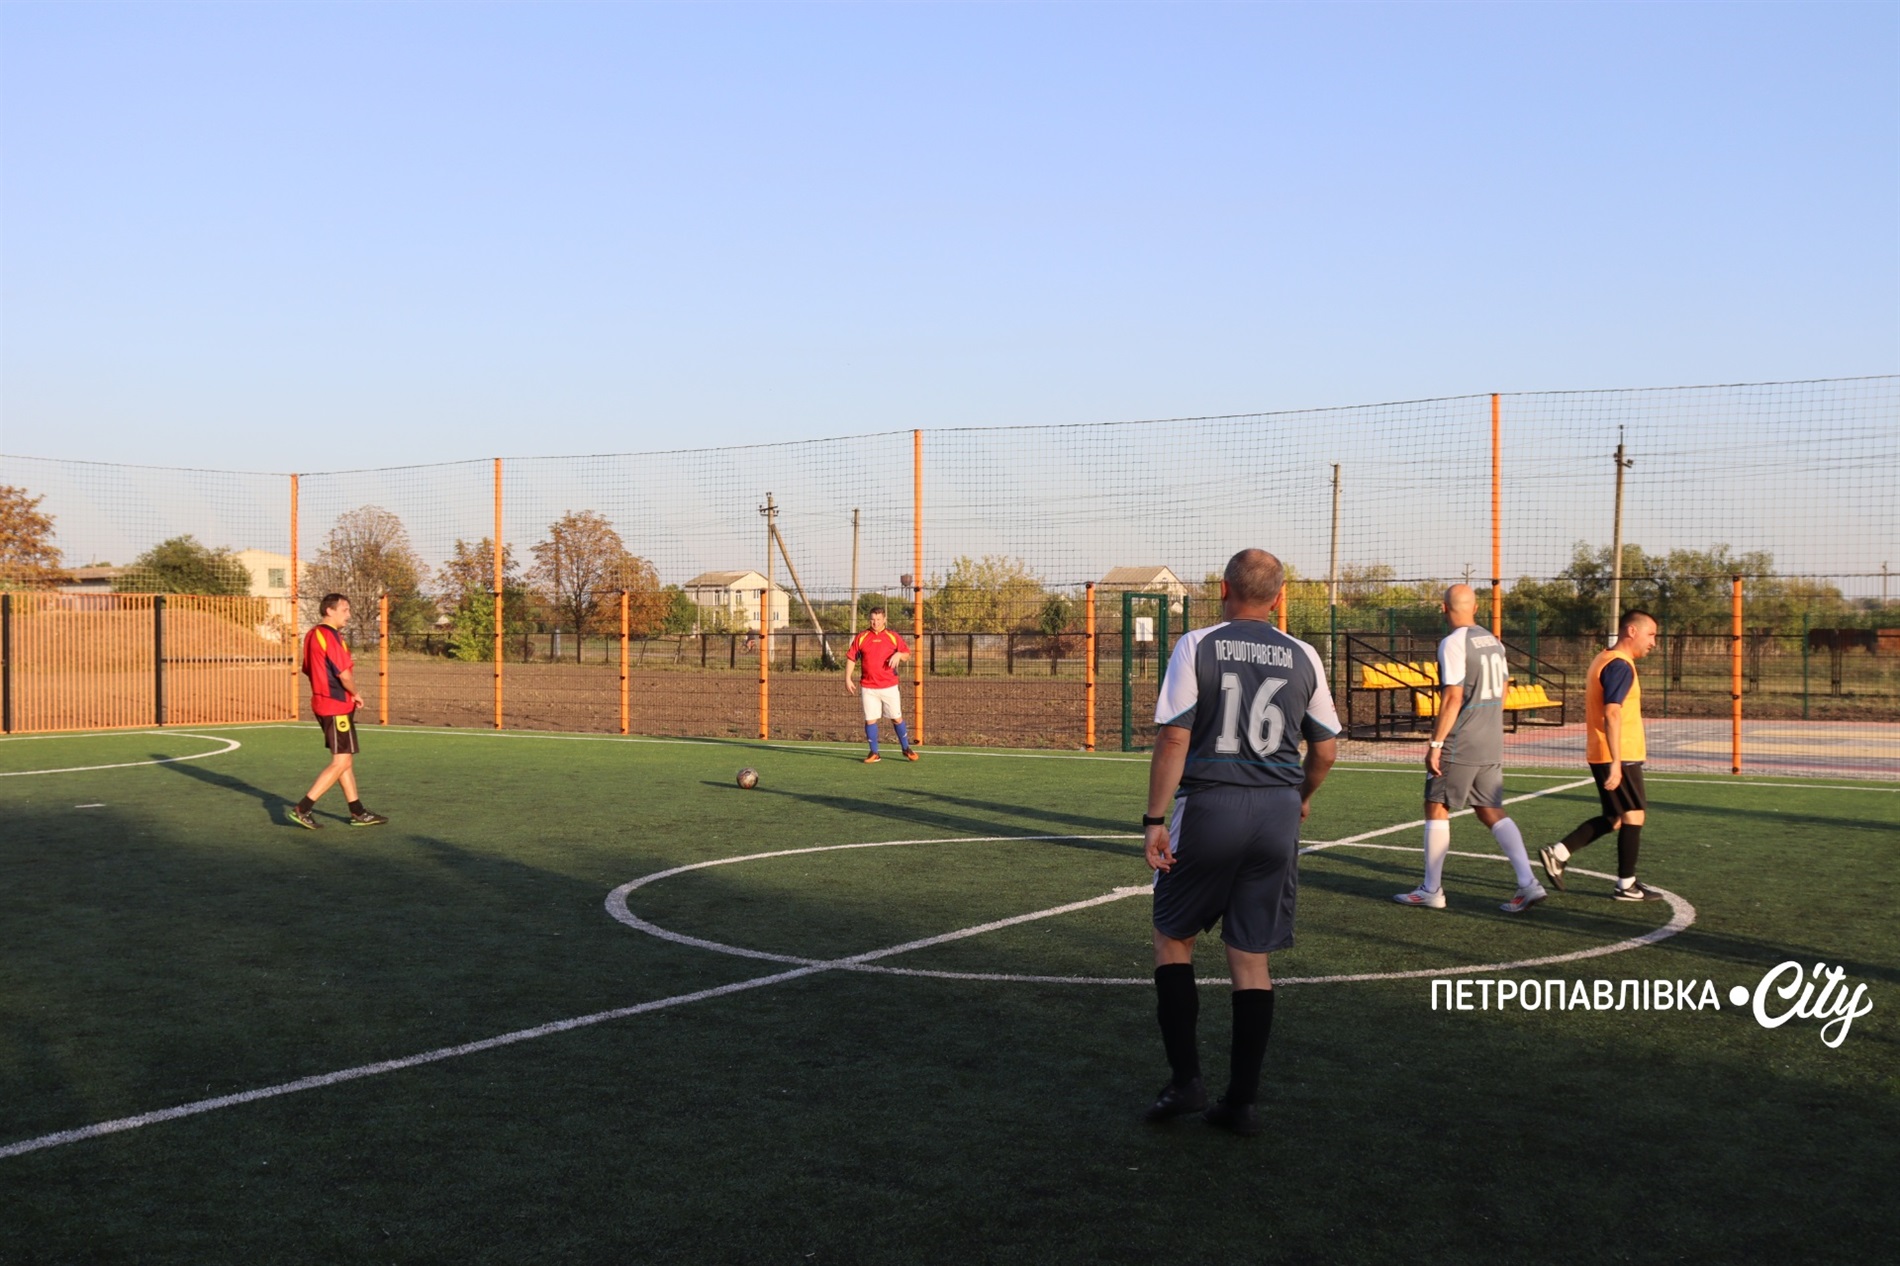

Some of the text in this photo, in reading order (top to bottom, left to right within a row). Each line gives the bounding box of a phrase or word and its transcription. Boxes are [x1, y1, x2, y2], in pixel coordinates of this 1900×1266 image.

[1215, 640, 1293, 669] ПЕРШОТРАВЕНСЬК
[1480, 653, 1504, 700] 10
[1215, 672, 1288, 757] 16
